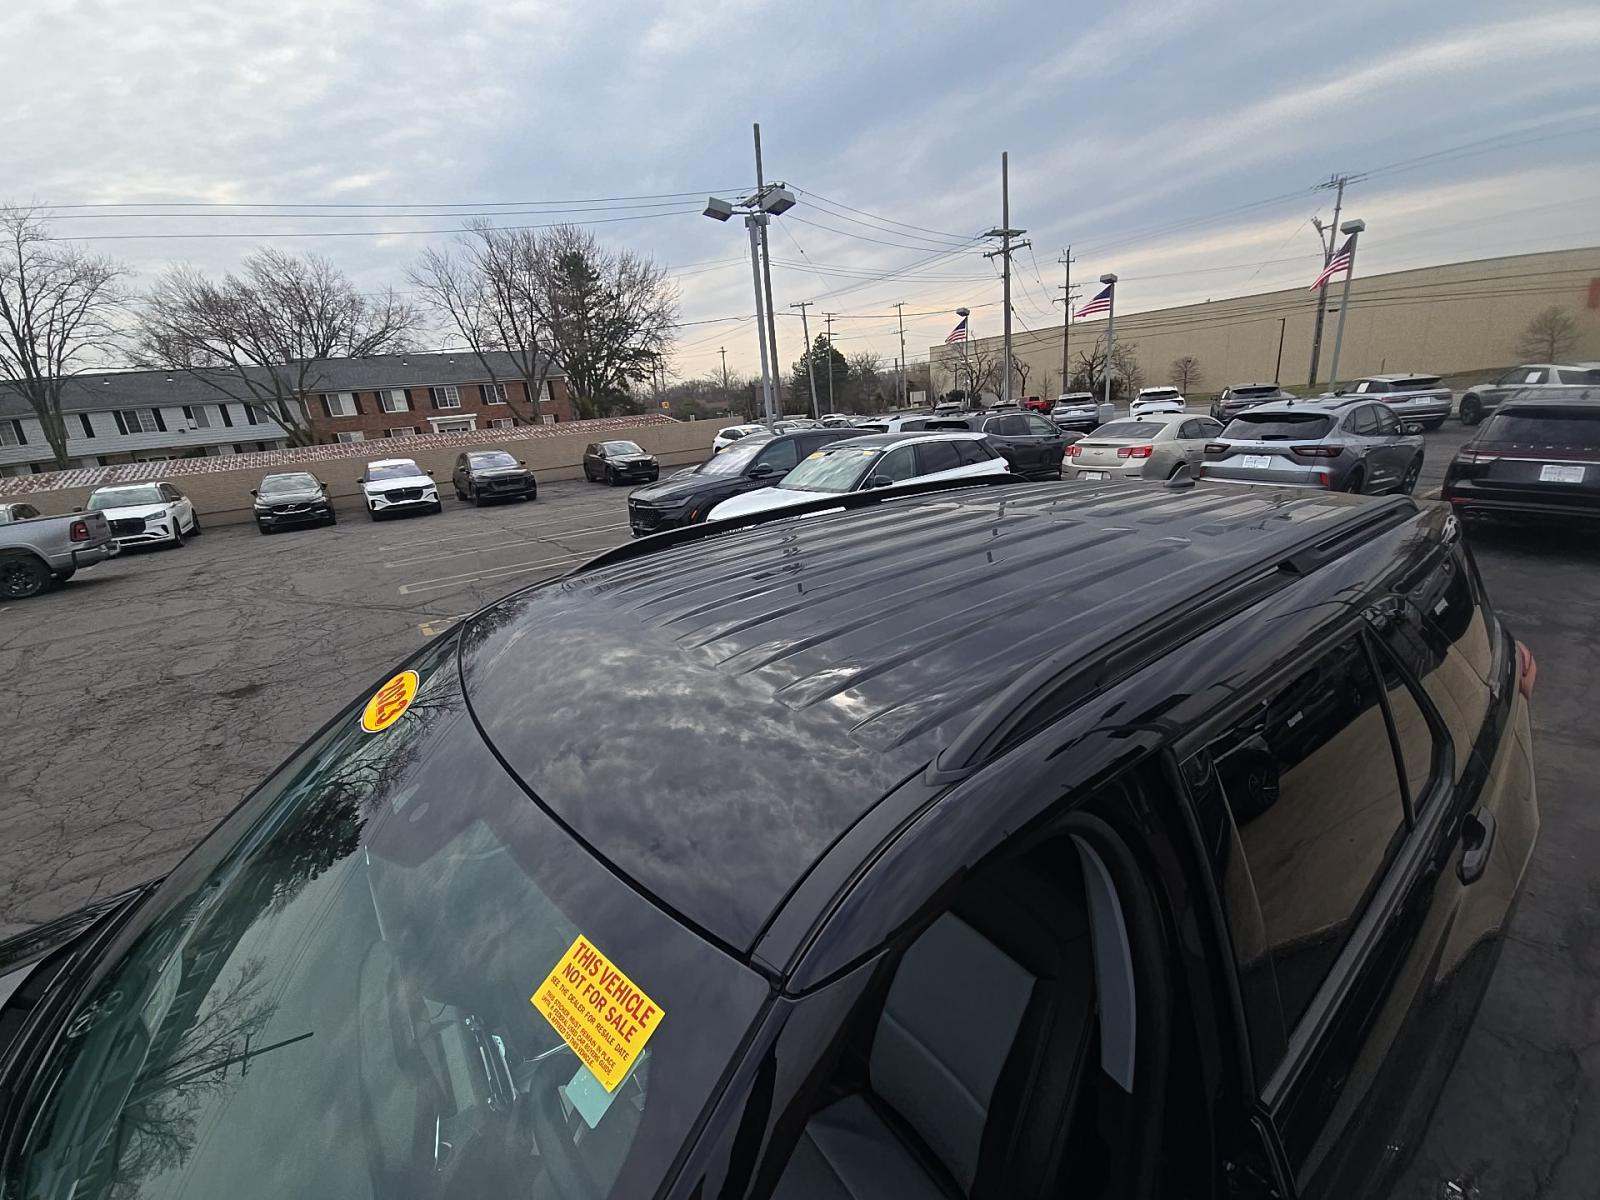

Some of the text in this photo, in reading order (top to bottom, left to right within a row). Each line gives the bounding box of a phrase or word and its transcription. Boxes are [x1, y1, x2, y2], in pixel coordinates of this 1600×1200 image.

[550, 975, 629, 1061] SEE THE DEALER FOR RESALE DATE
[561, 962, 637, 1043] NOT FOR SALE
[571, 941, 656, 1029] THIS VEHICLE
[580, 1028, 597, 1048] REMAIN
[600, 1050, 616, 1069] PLACE
[597, 1059, 612, 1076] GUIDE
